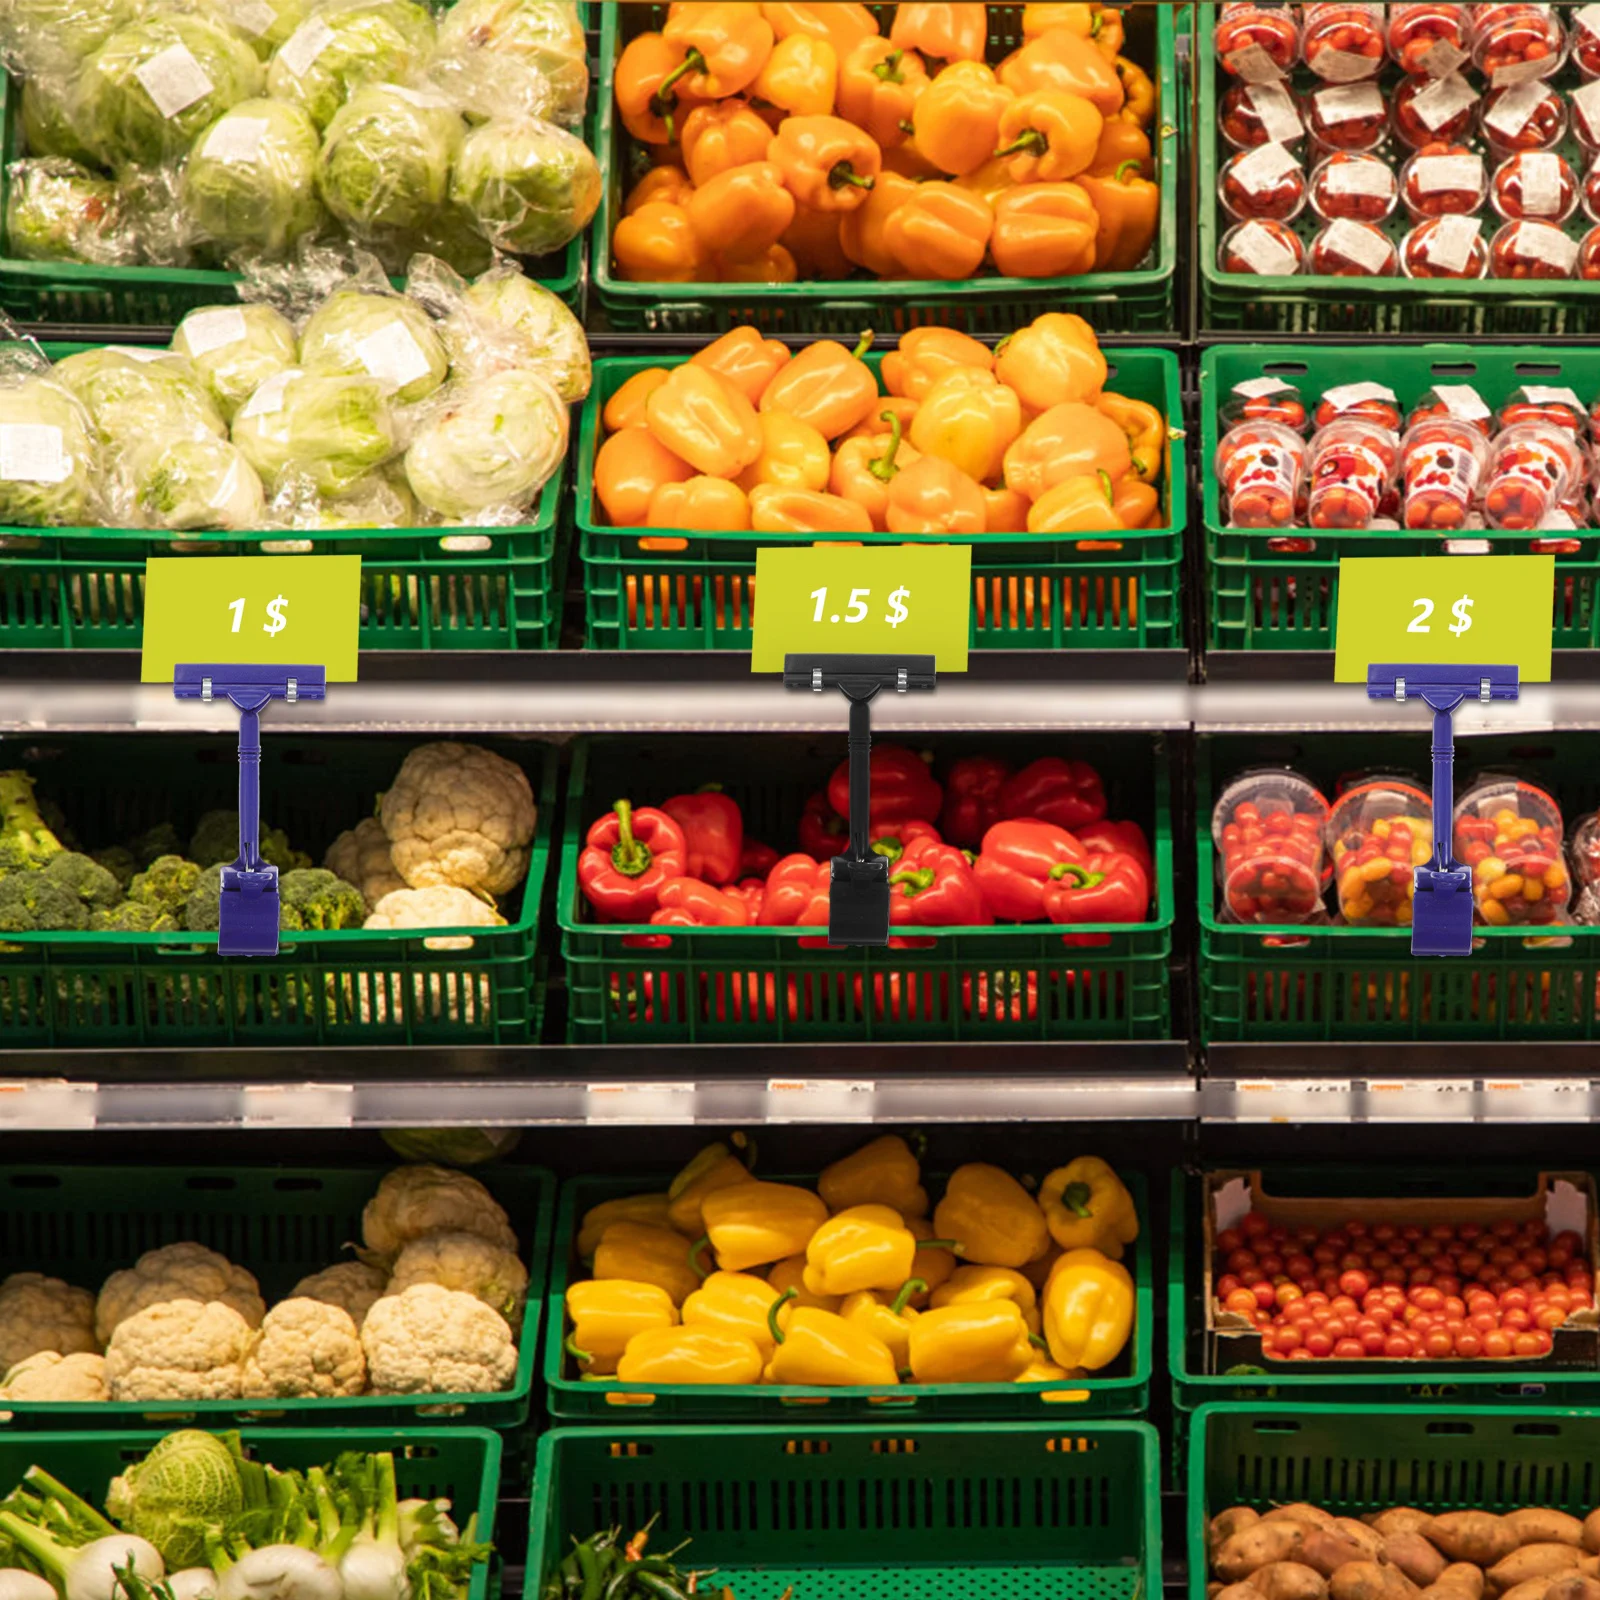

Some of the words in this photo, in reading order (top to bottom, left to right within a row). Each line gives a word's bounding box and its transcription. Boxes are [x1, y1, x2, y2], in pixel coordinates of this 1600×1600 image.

[228, 597, 246, 633] 1
[262, 594, 289, 638] $
[810, 586, 871, 623] 1.5
[884, 585, 911, 629] $
[1406, 597, 1435, 633] 2
[1448, 594, 1475, 638] $
